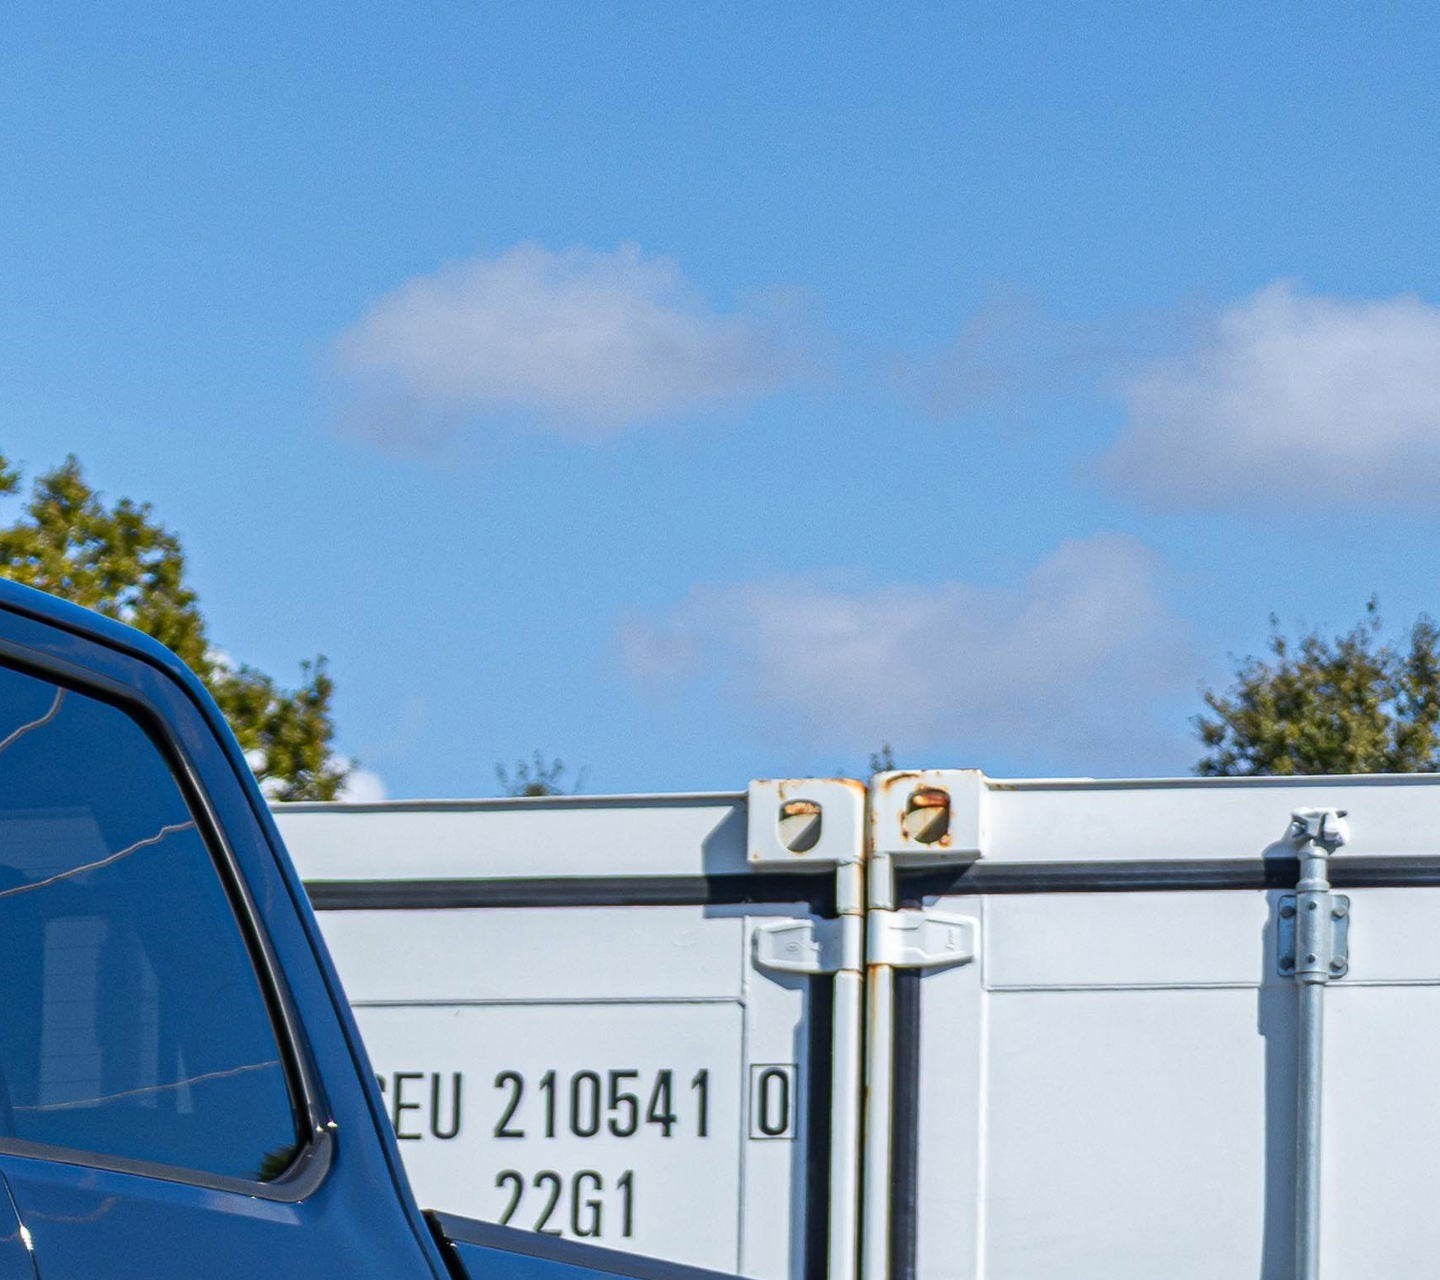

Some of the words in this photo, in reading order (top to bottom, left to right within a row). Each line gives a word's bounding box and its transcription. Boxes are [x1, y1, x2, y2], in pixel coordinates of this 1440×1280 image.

[376, 1071, 463, 1140] EU
[492, 1067, 711, 1139] 210541
[757, 1065, 791, 1137] 0
[494, 1168, 636, 1238] 22G1
